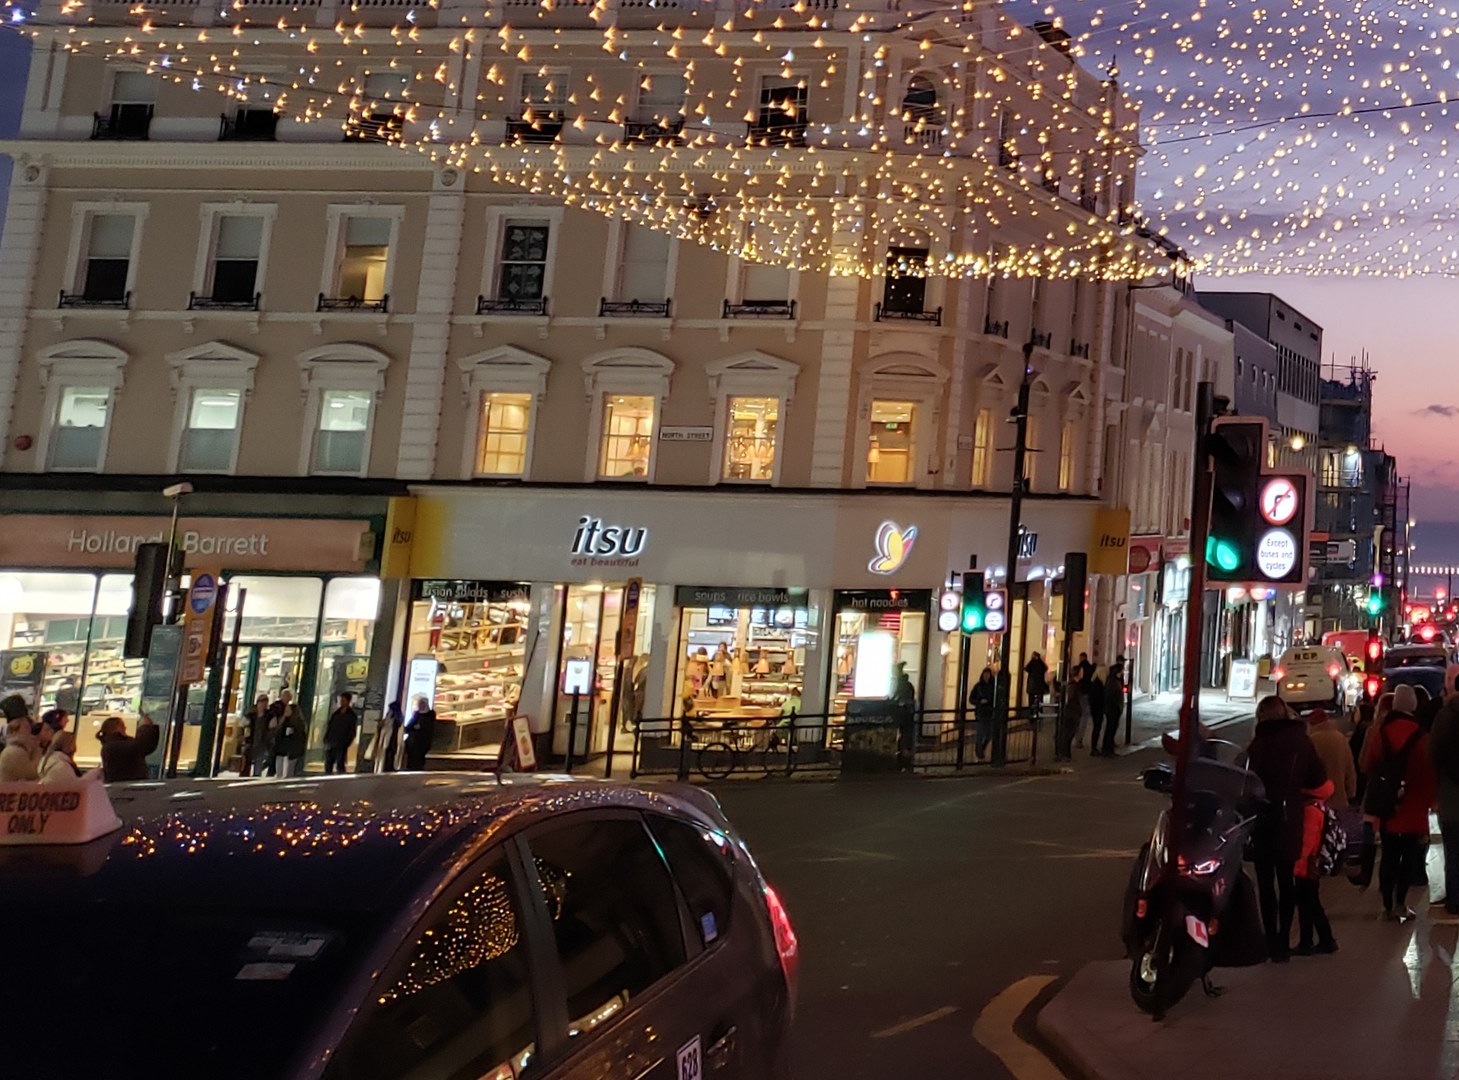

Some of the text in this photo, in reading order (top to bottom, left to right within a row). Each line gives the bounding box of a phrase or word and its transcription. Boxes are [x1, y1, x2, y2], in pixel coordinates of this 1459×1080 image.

[182, 530, 269, 556] Barrett
[392, 527, 412, 545] itsu
[571, 516, 647, 556] itsu
[1100, 533, 1126, 548] itsu
[1267, 538, 1288, 548] Except
[1261, 550, 1293, 559] buses and
[570, 557, 640, 567] eat beautiful
[1266, 562, 1286, 571] cycles
[695, 591, 789, 604] soups rice bowls
[851, 597, 909, 607] hot noodles
[18, 791, 81, 812] BOOKED
[8, 813, 49, 834] ONLY
